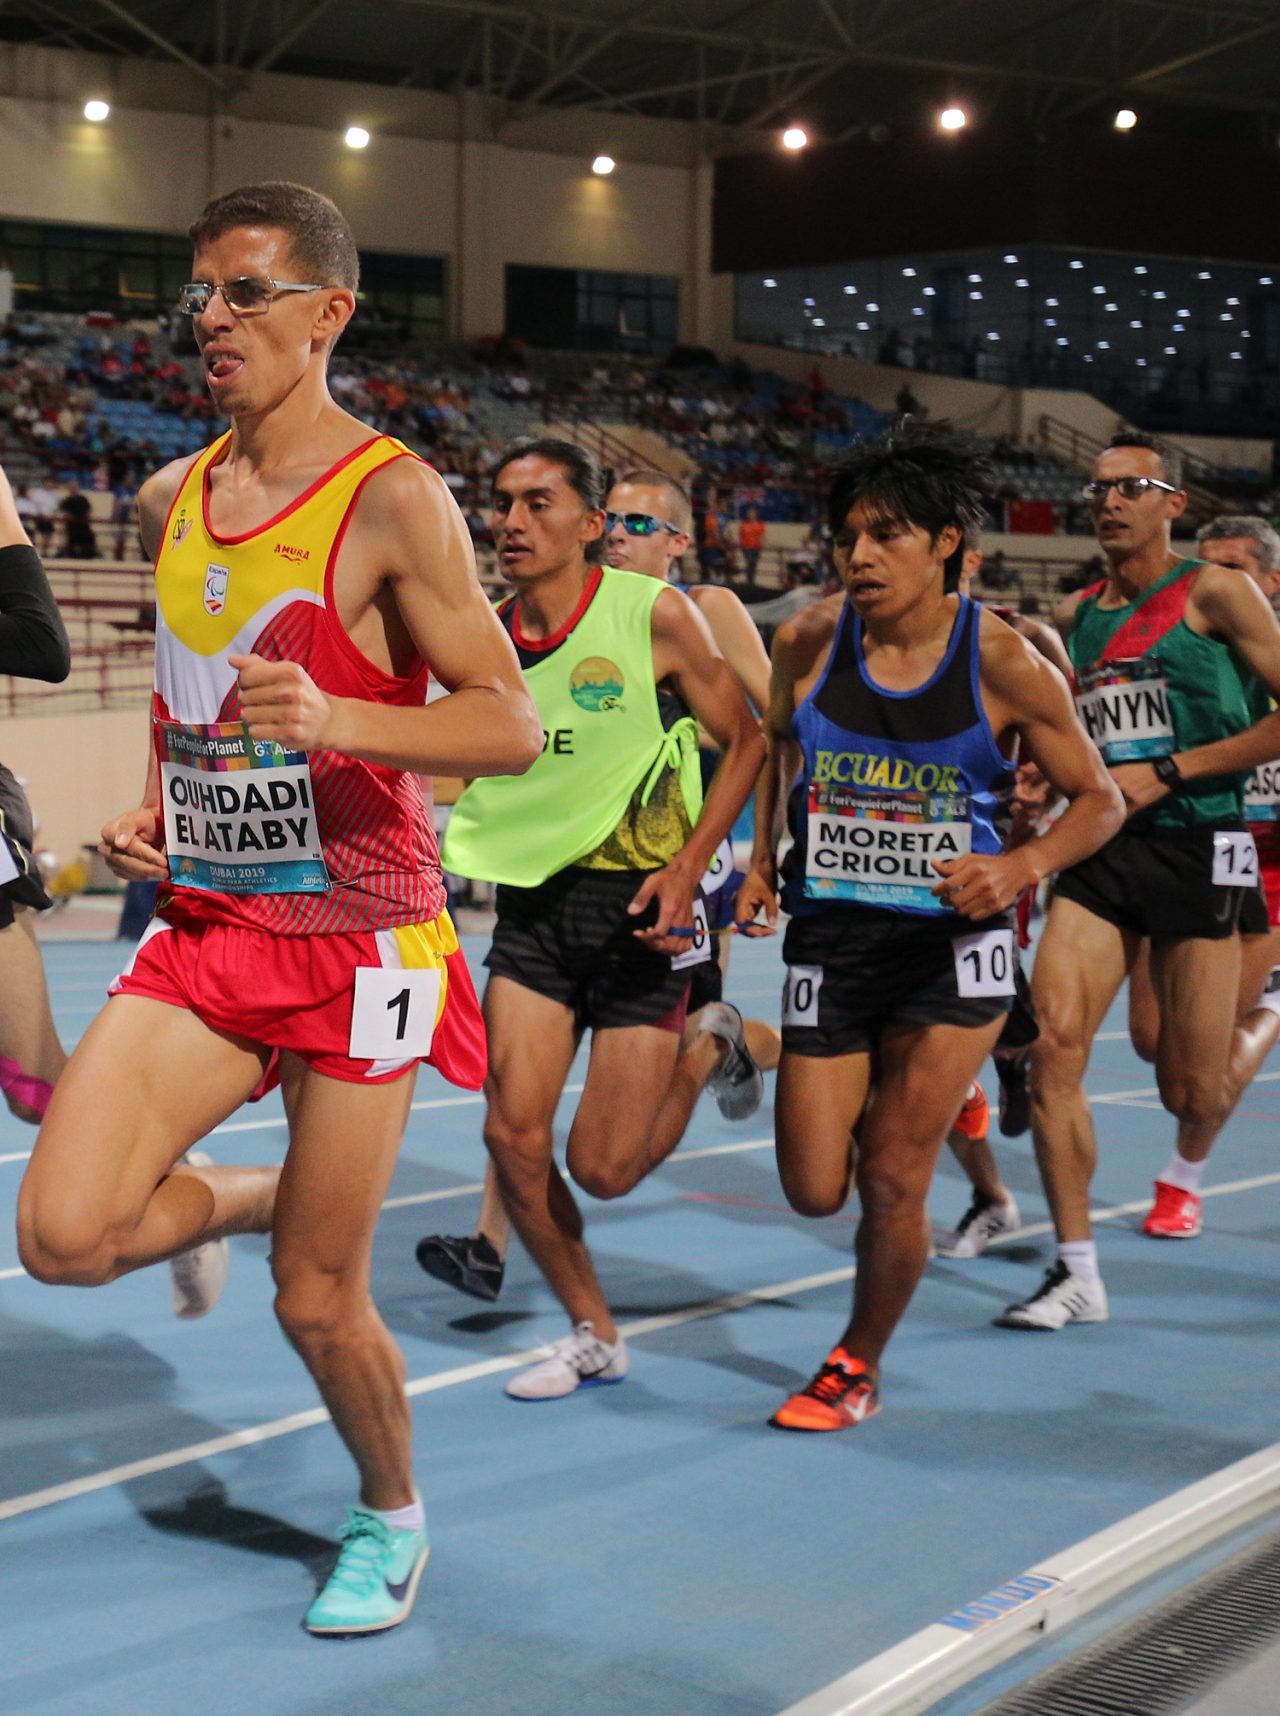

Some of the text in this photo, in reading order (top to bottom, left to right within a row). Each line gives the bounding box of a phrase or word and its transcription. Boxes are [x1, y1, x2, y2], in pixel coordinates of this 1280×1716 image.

[273, 543, 310, 561] AMURA
[166, 731, 245, 757] #ForPeopleForPlanet
[813, 751, 961, 792] ECUADOR
[170, 776, 310, 815] OUHDADI
[175, 813, 308, 852] EL ATABY
[819, 822, 959, 854] MORETA
[209, 866, 266, 878] DUBAI 2019
[814, 848, 958, 879] CRIOLL
[1221, 844, 1256, 875] 12
[963, 944, 1007, 983] 10
[387, 988, 411, 1040] 1
[942, 1575, 1053, 1631] MONDO
